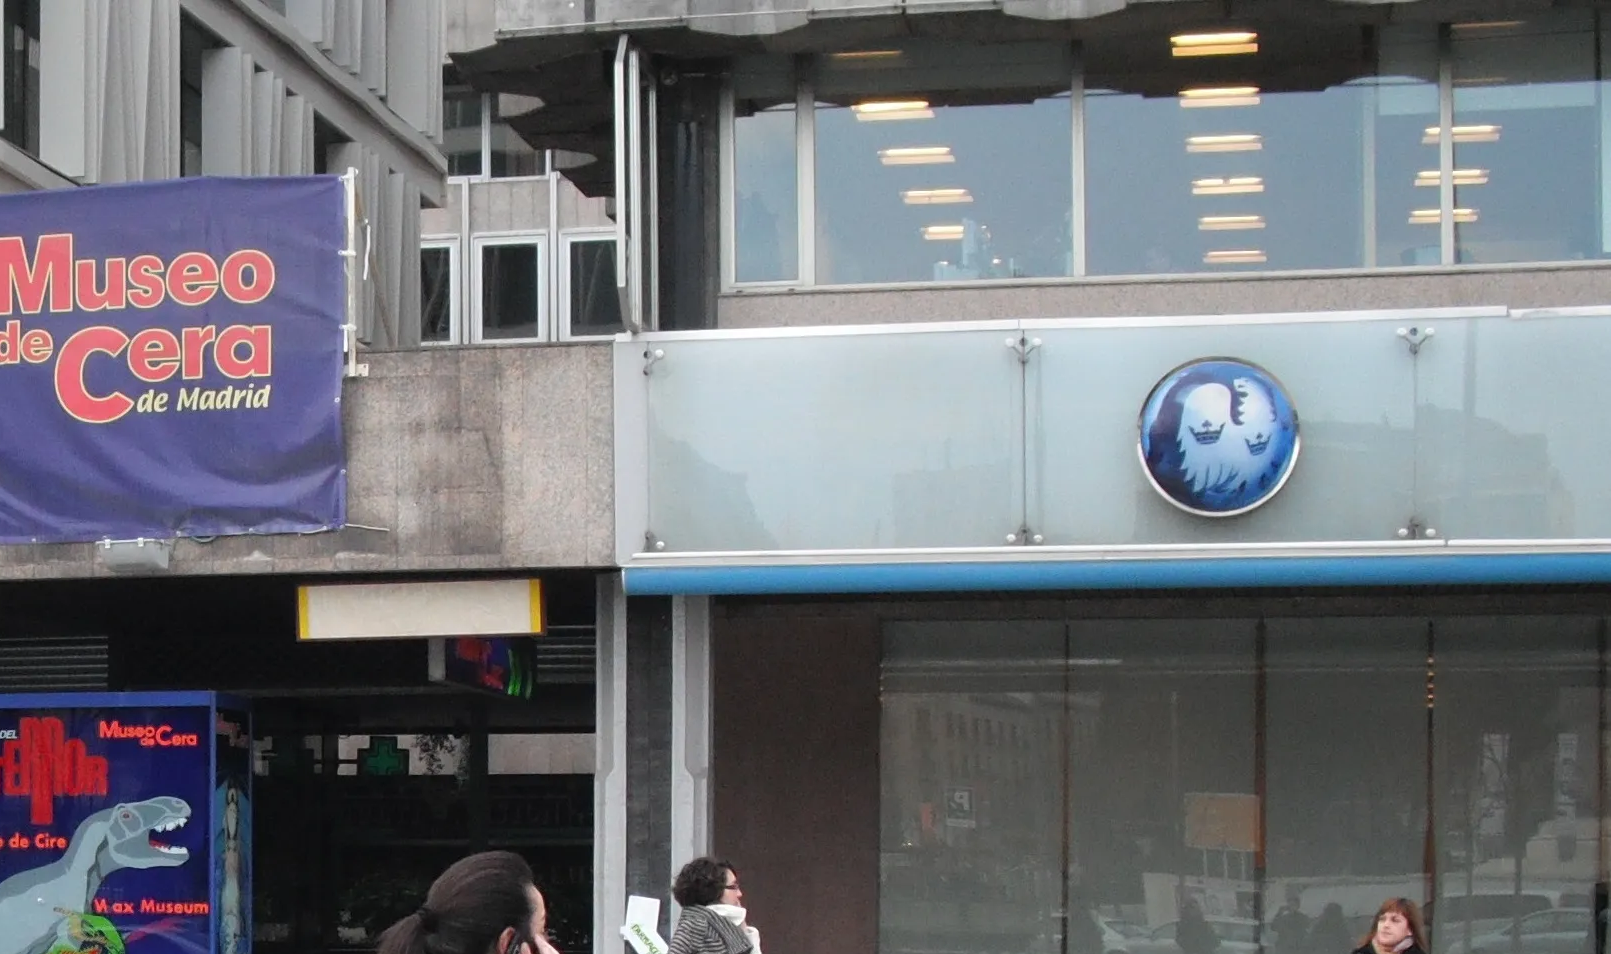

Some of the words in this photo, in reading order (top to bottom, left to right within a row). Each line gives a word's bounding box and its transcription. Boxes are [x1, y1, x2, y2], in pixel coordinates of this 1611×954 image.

[54, 325, 272, 424] Cera
[136, 389, 167, 413] de
[176, 383, 270, 412] Madrid
[0, 729, 18, 740] DEL
[99, 720, 155, 739] Museo
[140, 737, 155, 746] de
[155, 725, 197, 746] Cera
[8, 832, 30, 849] de
[34, 832, 67, 849] Cire
[140, 898, 209, 914] Museum
